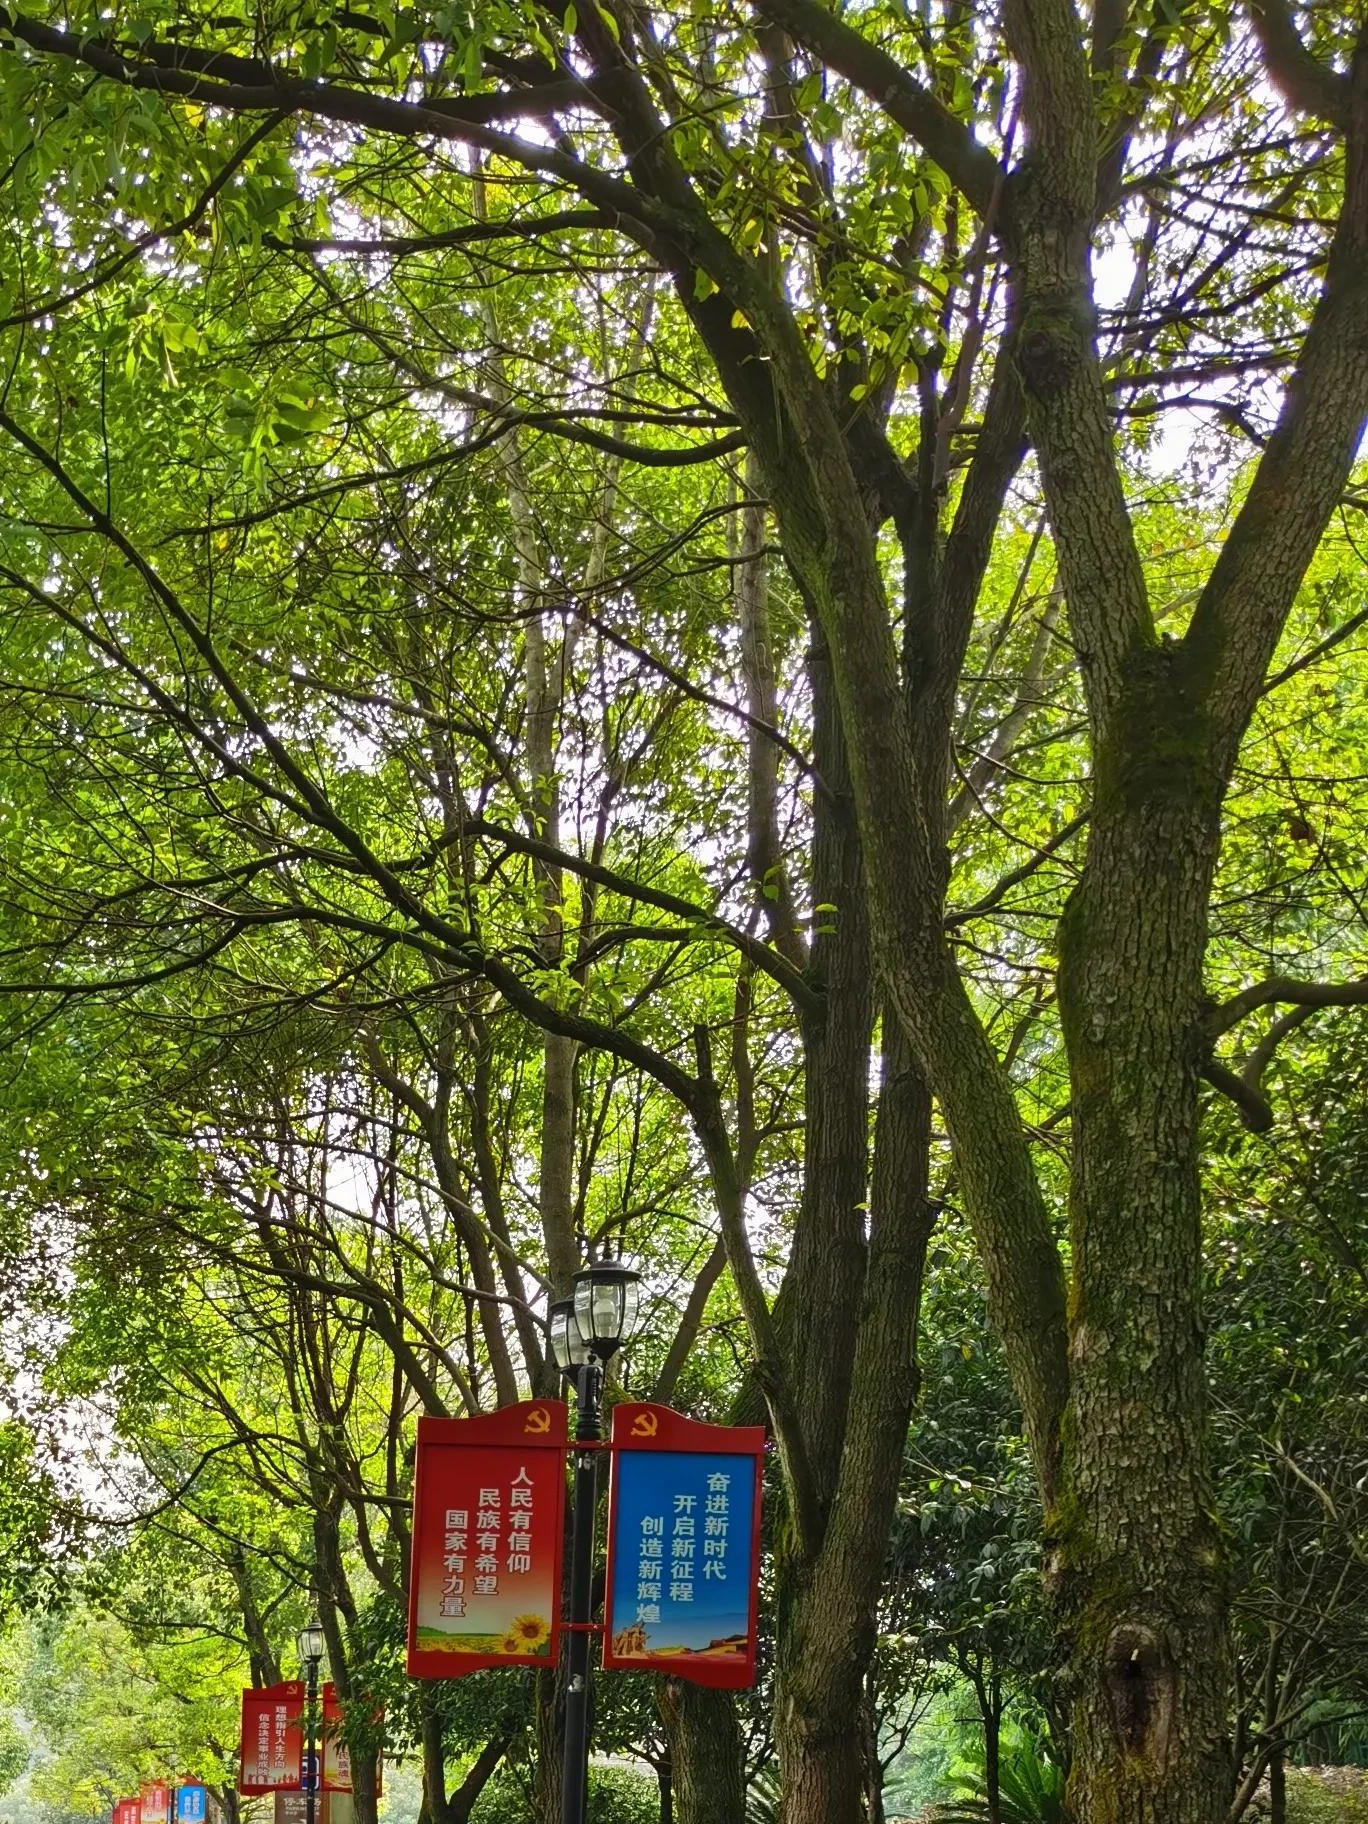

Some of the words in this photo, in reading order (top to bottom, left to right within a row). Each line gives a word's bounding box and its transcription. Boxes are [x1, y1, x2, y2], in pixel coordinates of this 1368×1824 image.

[440, 1510, 469, 1617] 国家有力量
[472, 1488, 501, 1595] 民族有希望
[506, 1466, 535, 1574] 人民有信仰
[636, 1516, 664, 1624] 创造新辉煌
[669, 1494, 697, 1602] 开启新征程
[703, 1472, 731, 1580] 奋进新时代
[274, 1706, 287, 1768] 理想指引人生方向
